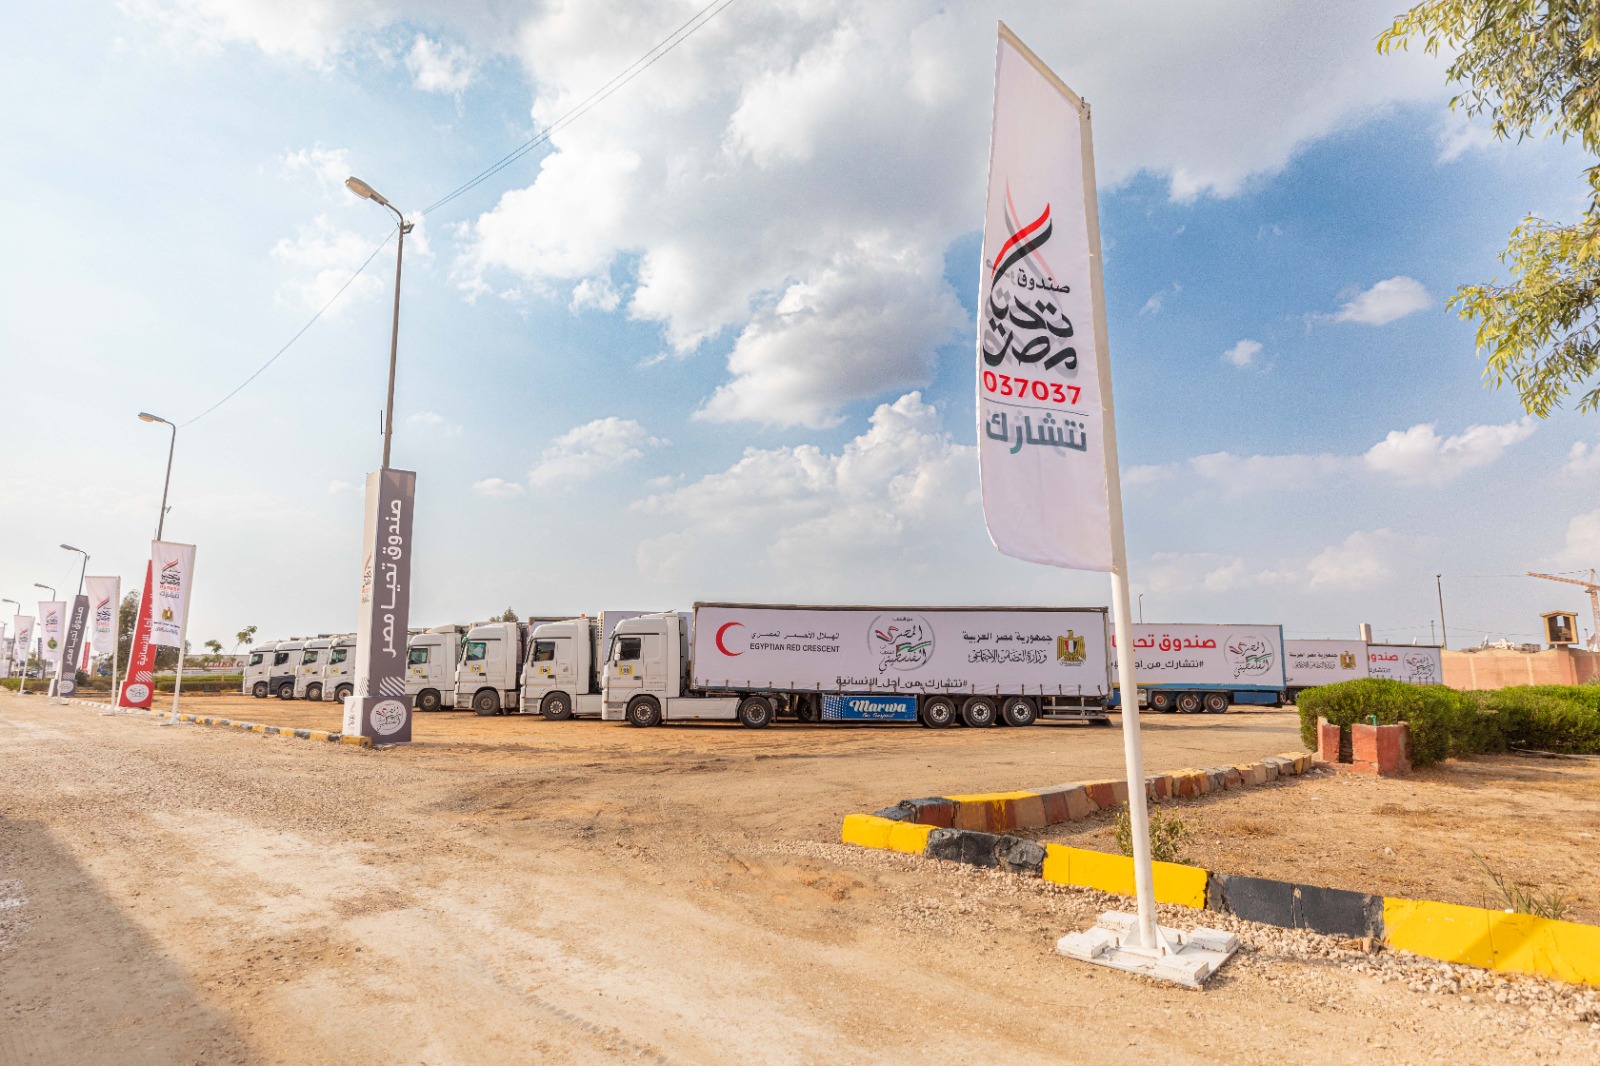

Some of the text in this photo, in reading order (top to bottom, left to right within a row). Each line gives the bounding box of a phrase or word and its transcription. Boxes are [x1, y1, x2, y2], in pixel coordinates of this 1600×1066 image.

[1017, 266, 1071, 294] صندوق
[983, 369, 1081, 405] 037037
[985, 411, 1088, 454] نتشارك
[380, 499, 402, 659] صندوق تحيا مصر
[749, 642, 840, 653] EGYPTIAN RED CRESCENT
[962, 631, 1053, 645] جمهورية مصر العربية
[1158, 634, 1217, 652] صندوق
[849, 699, 908, 713] Marwa
